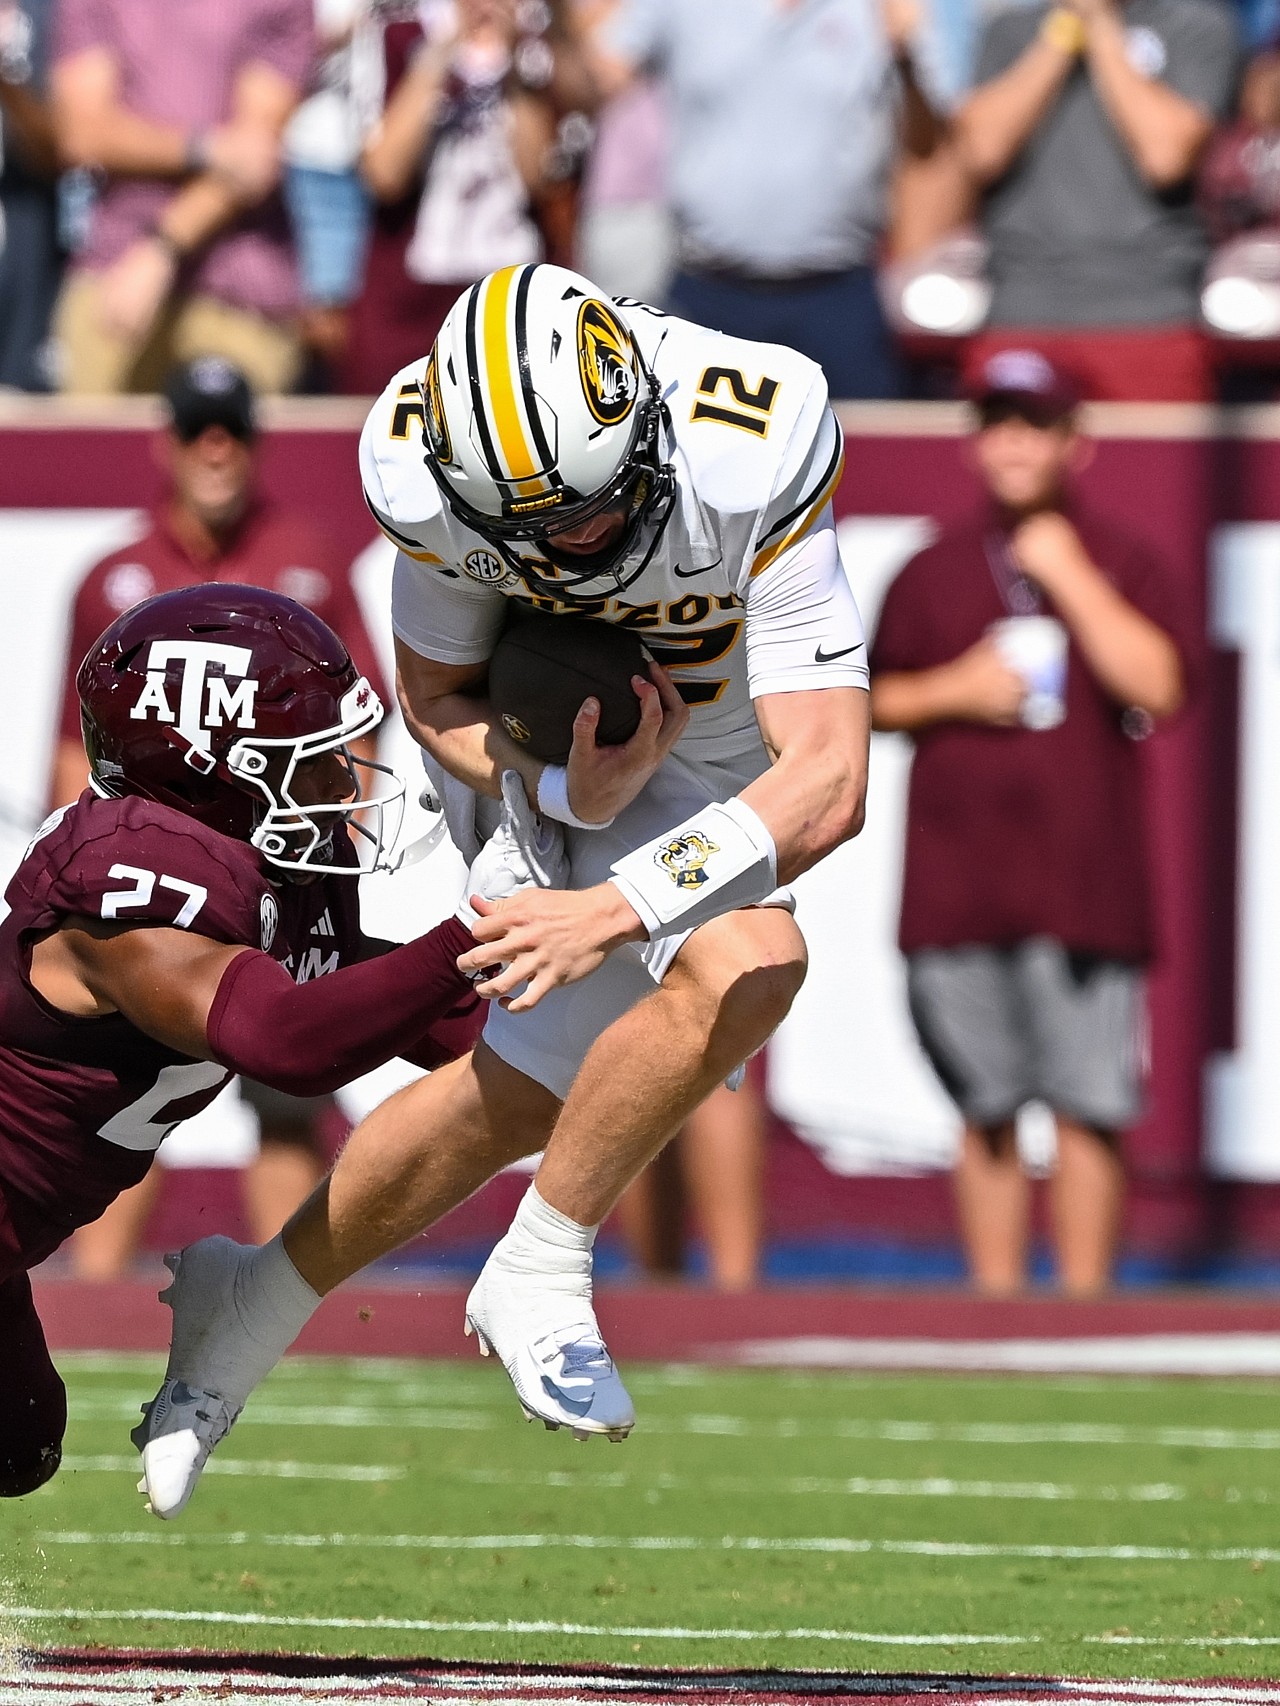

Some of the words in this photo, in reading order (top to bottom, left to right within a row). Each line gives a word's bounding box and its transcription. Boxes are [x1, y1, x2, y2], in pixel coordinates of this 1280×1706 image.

[690, 365, 781, 440] 12
[510, 492, 563, 514] MIZZOU
[466, 551, 501, 579] SEC
[101, 863, 208, 929] 27
